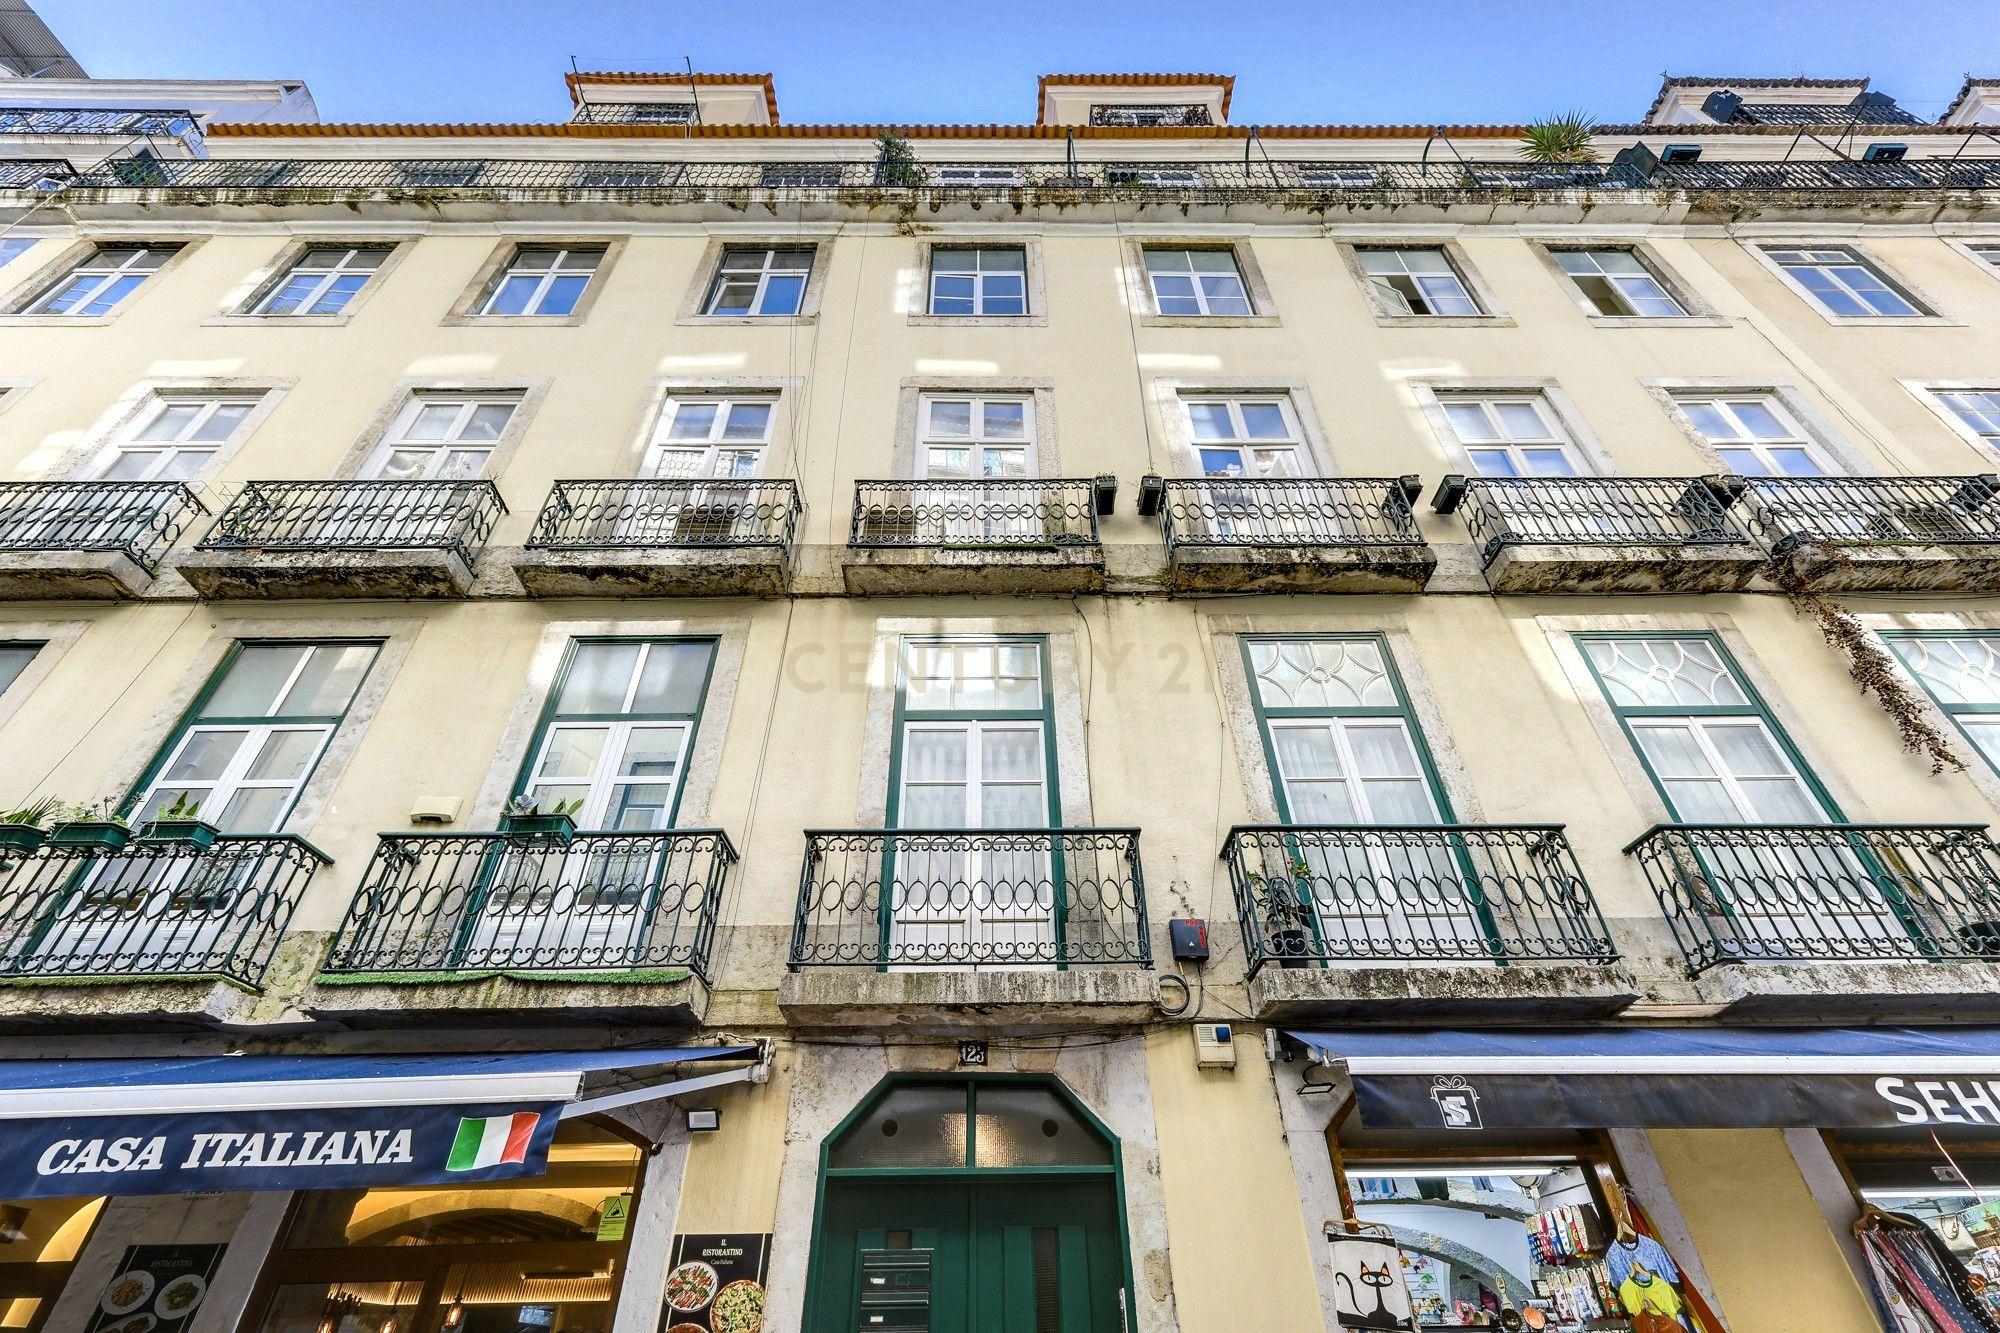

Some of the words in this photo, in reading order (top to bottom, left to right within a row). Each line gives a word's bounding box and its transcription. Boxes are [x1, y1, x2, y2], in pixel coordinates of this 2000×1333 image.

[36, 1136, 167, 1176] CASA
[181, 1128, 413, 1169] ITALIANA
[702, 1248, 743, 1256] RISTORANTINO
